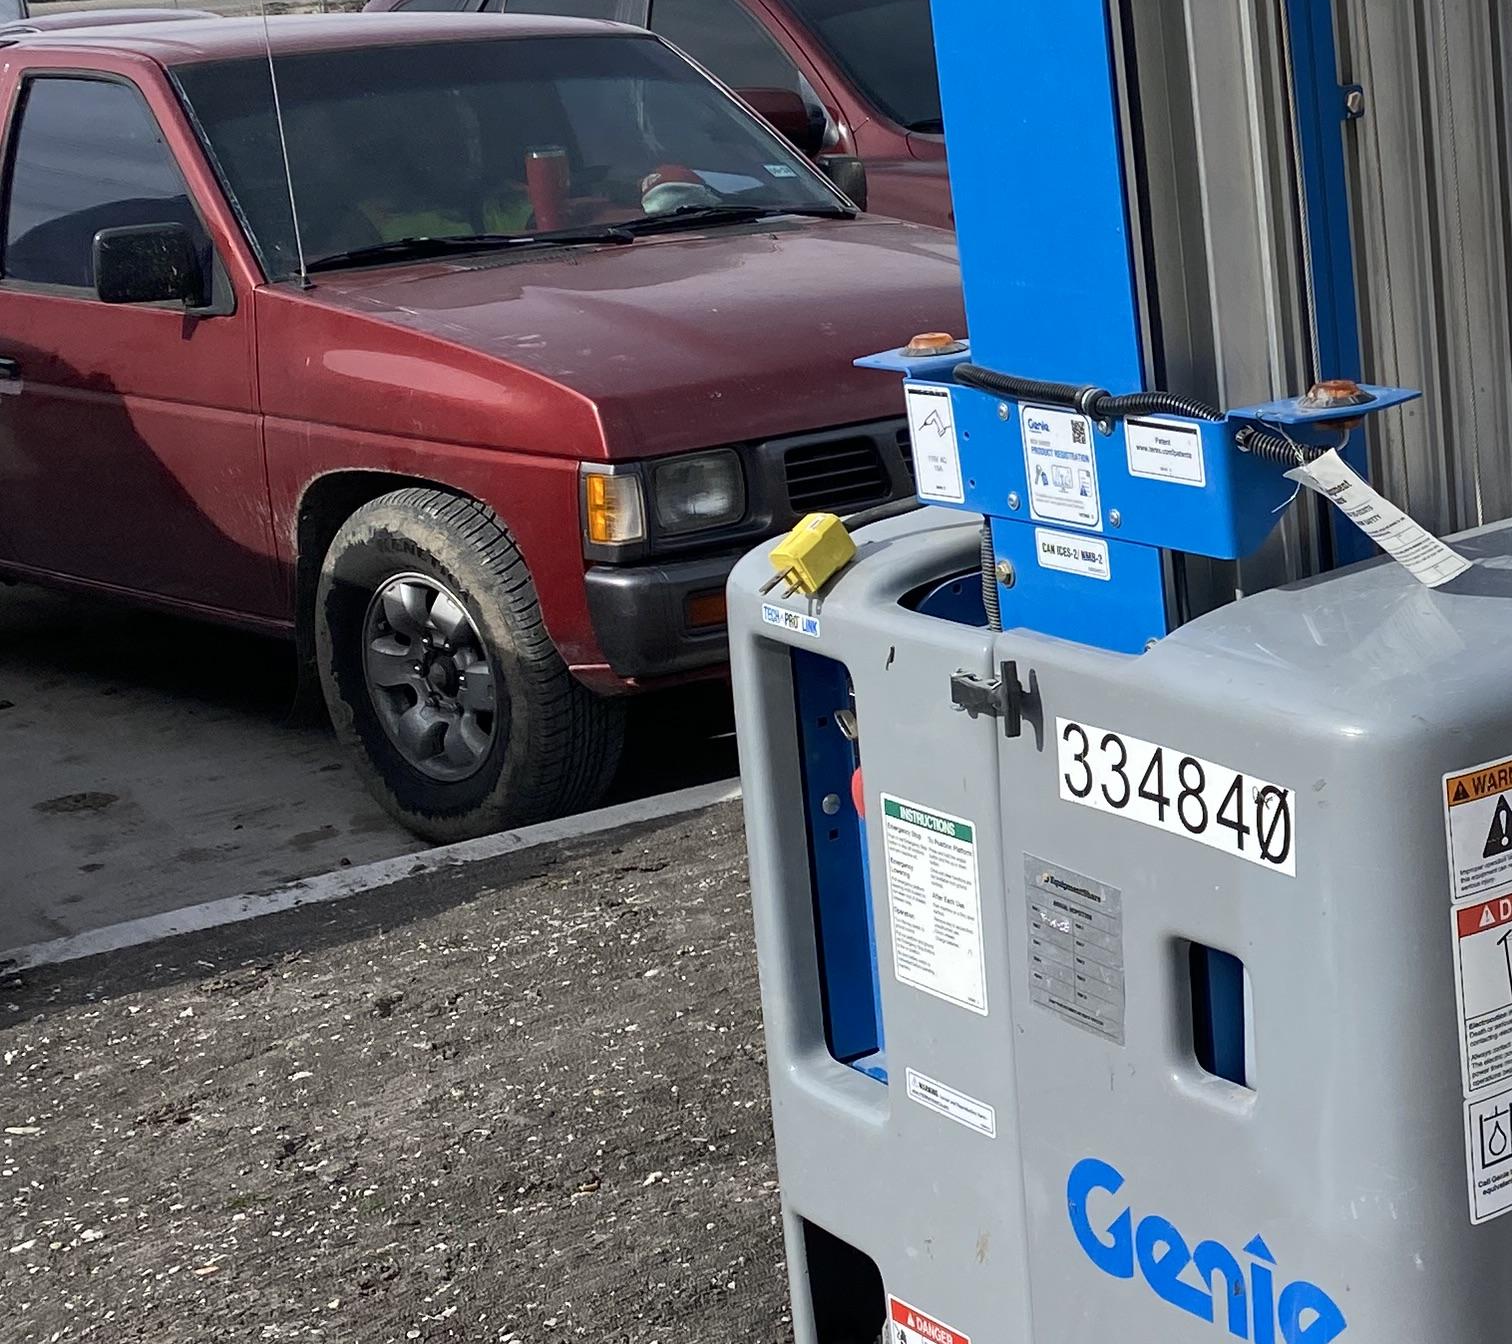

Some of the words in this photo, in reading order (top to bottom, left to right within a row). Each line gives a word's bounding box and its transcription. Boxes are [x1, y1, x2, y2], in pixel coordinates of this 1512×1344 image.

[802, 617, 818, 634] LINK
[1063, 723, 1291, 864] 334840
[900, 806, 956, 836] INSTRUCTIONS
